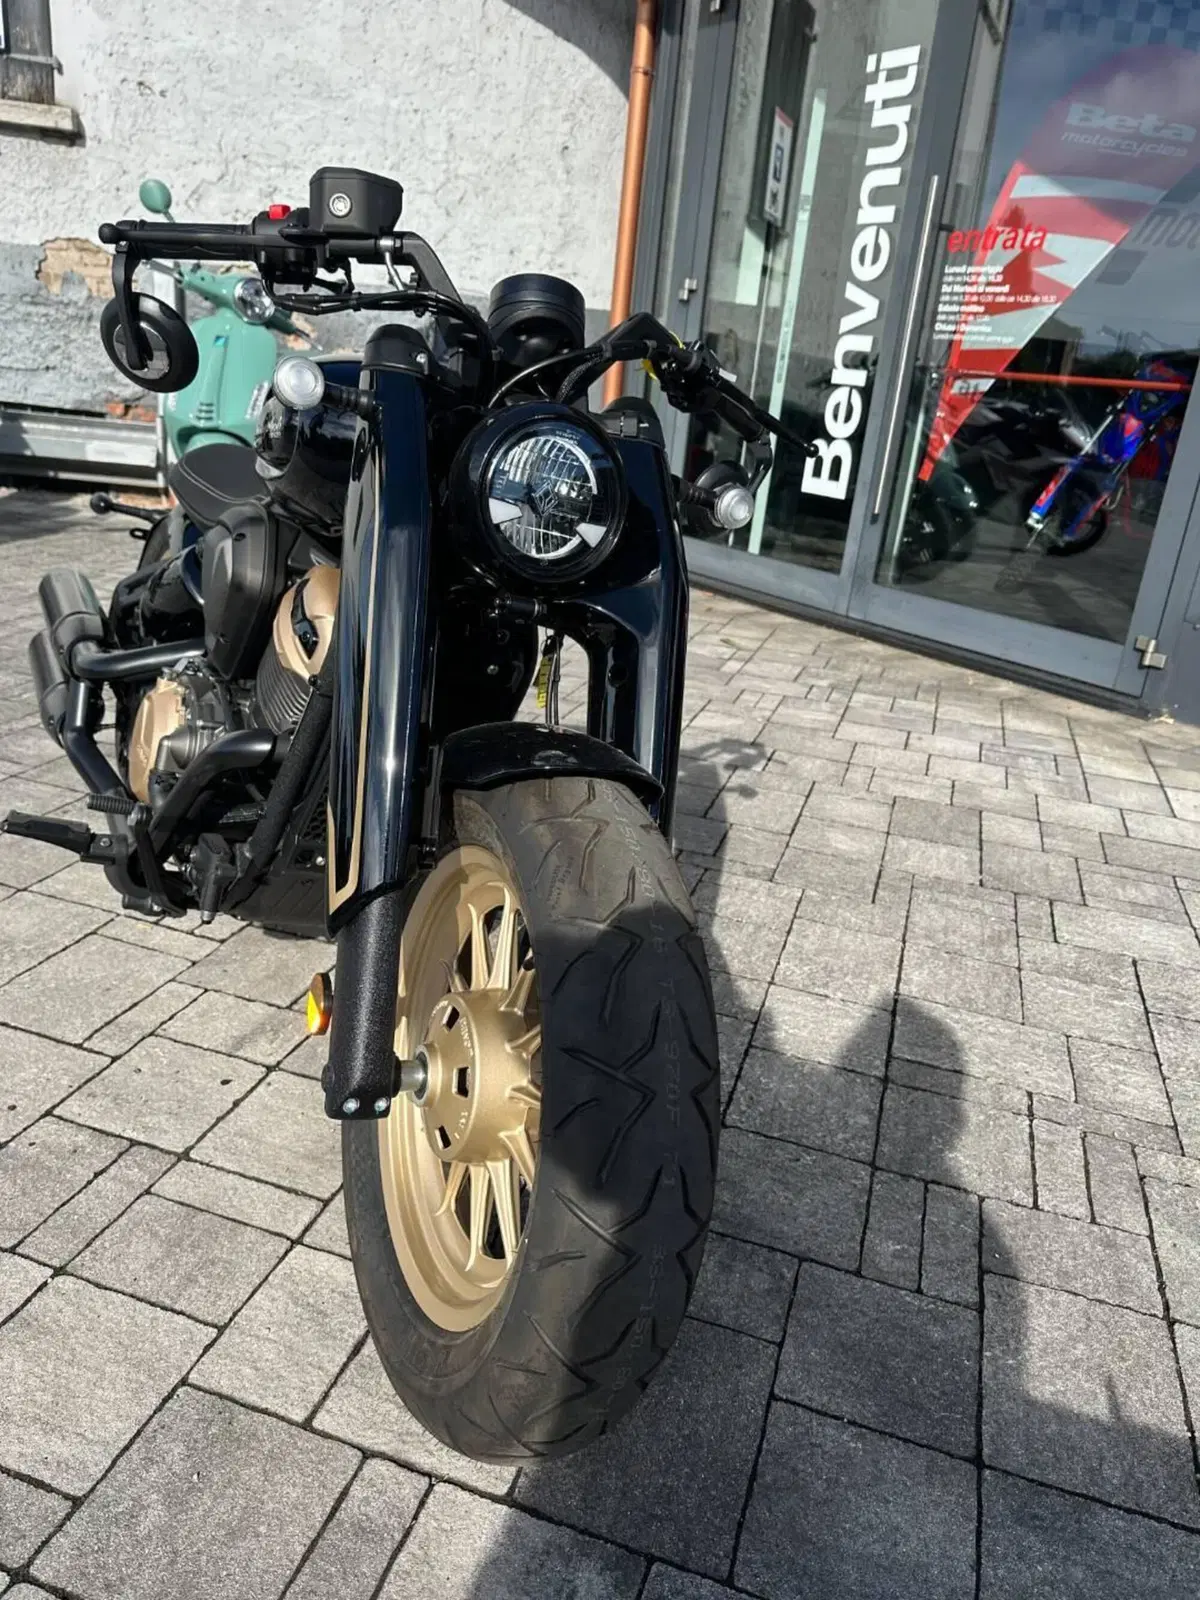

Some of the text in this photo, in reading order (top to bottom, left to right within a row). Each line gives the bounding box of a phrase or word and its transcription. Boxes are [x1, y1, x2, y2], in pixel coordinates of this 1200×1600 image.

[1065, 102, 1197, 142] Beta
[1060, 131, 1189, 158] motorcycles
[947, 224, 1048, 253] entrata
[800, 44, 922, 500] Benvenuti
